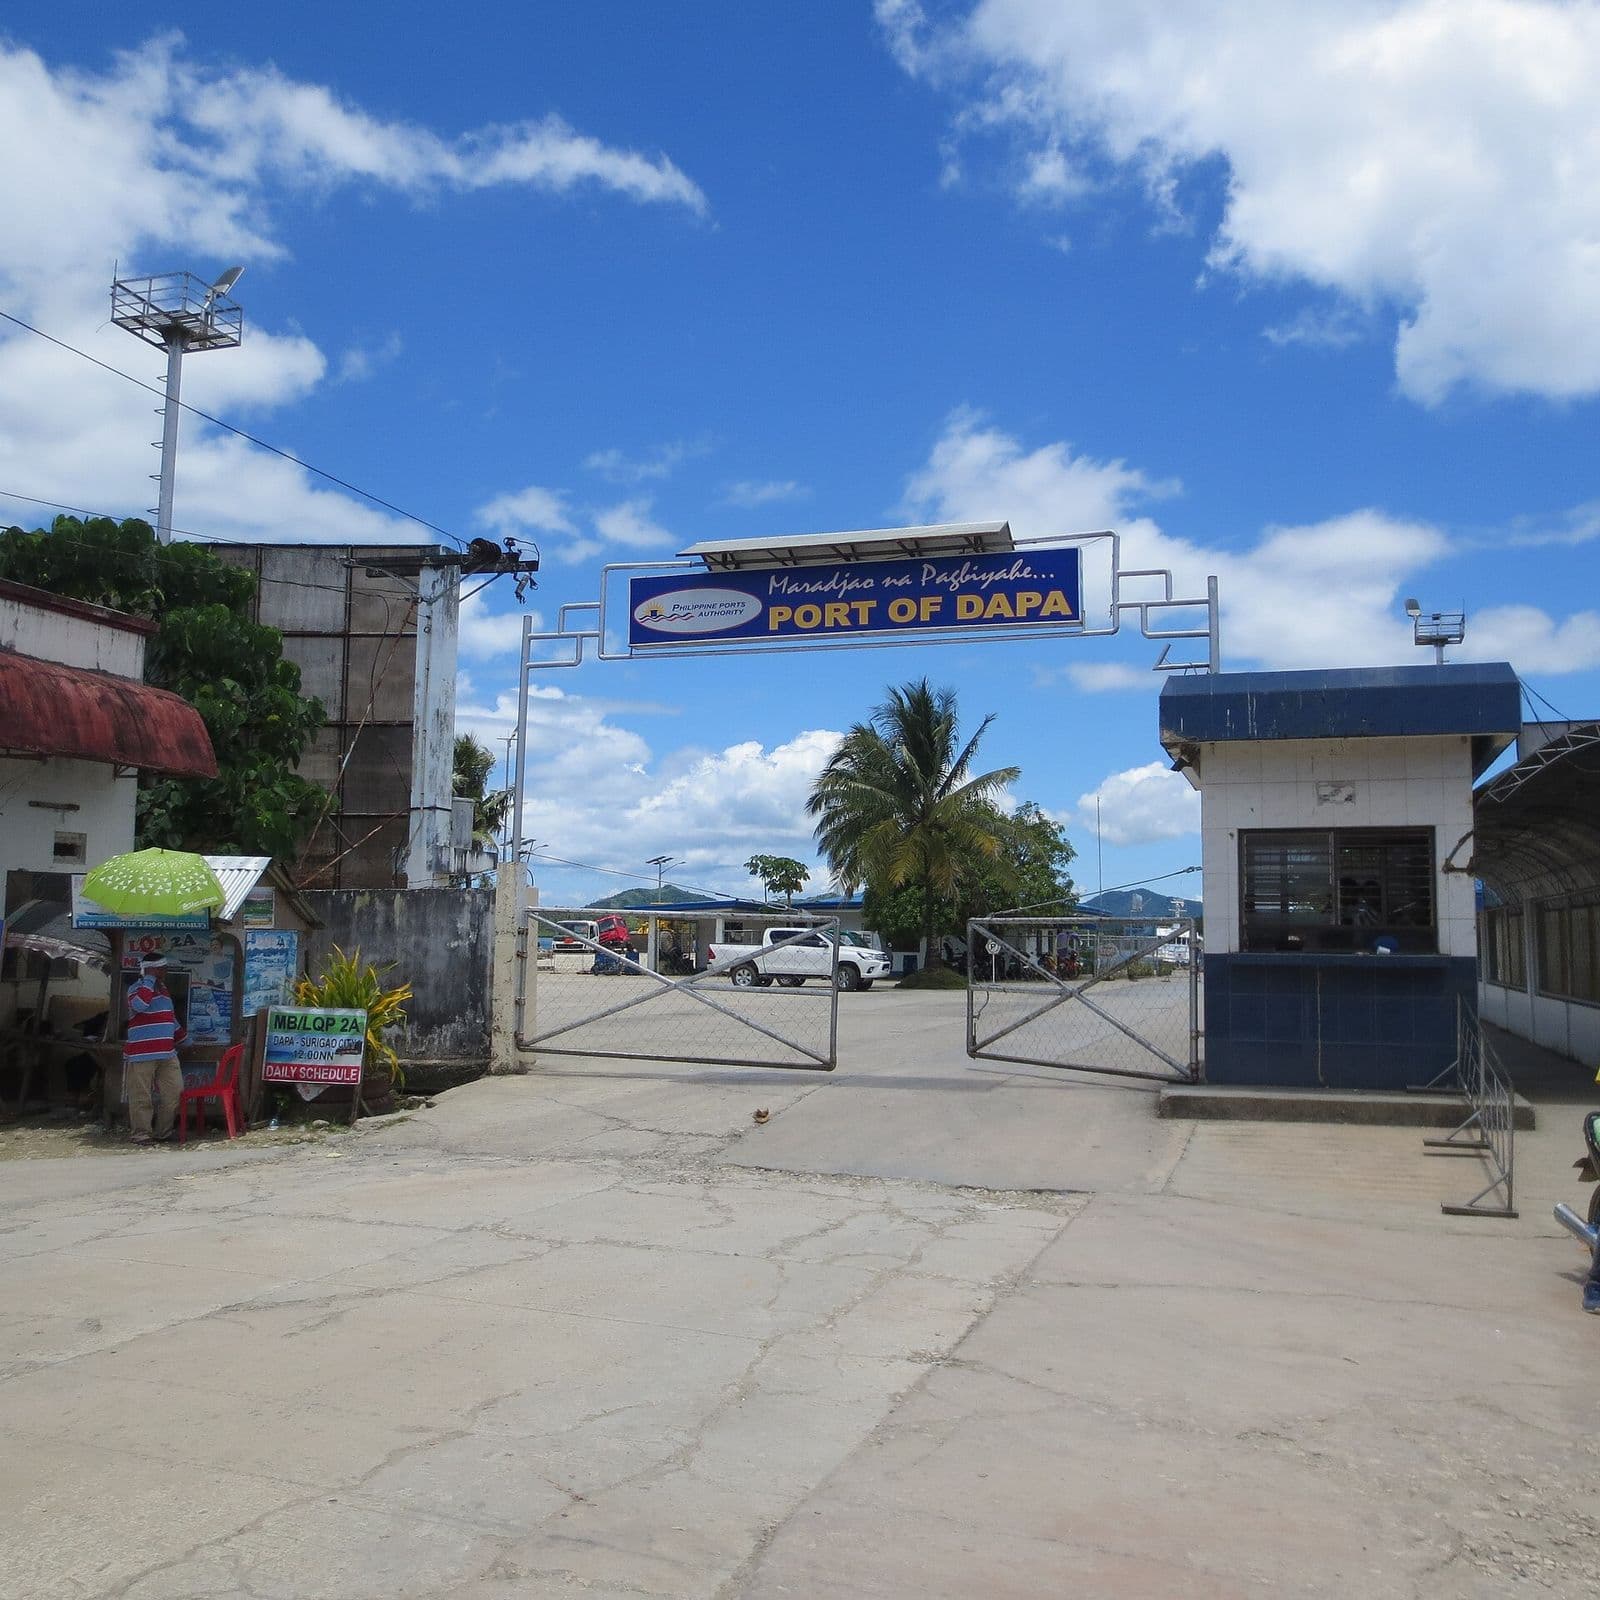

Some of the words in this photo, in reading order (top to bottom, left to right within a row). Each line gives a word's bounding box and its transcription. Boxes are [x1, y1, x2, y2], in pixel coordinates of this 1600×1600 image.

[768, 571, 875, 599] Maradjao
[882, 573, 912, 588] na
[719, 601, 746, 610] PORTS
[769, 601, 877, 631] PORT
[888, 596, 943, 624] OF
[957, 590, 1074, 620] DAPA
[698, 608, 745, 618] AUTHORITY
[79, 920, 96, 928] NEW
[97, 920, 137, 928] SCHEDULE
[171, 933, 197, 946] 2A
[274, 1015, 336, 1032] MB/LQP
[340, 1017, 360, 1032] 2A
[273, 1035, 294, 1046] DAPA
[301, 1037, 337, 1048] SURIGAO
[338, 1038, 358, 1049] CITY
[293, 1050, 334, 1060] 12:00NN
[265, 1065, 297, 1077] DAILY
[299, 1067, 357, 1080] SCHEDULE
